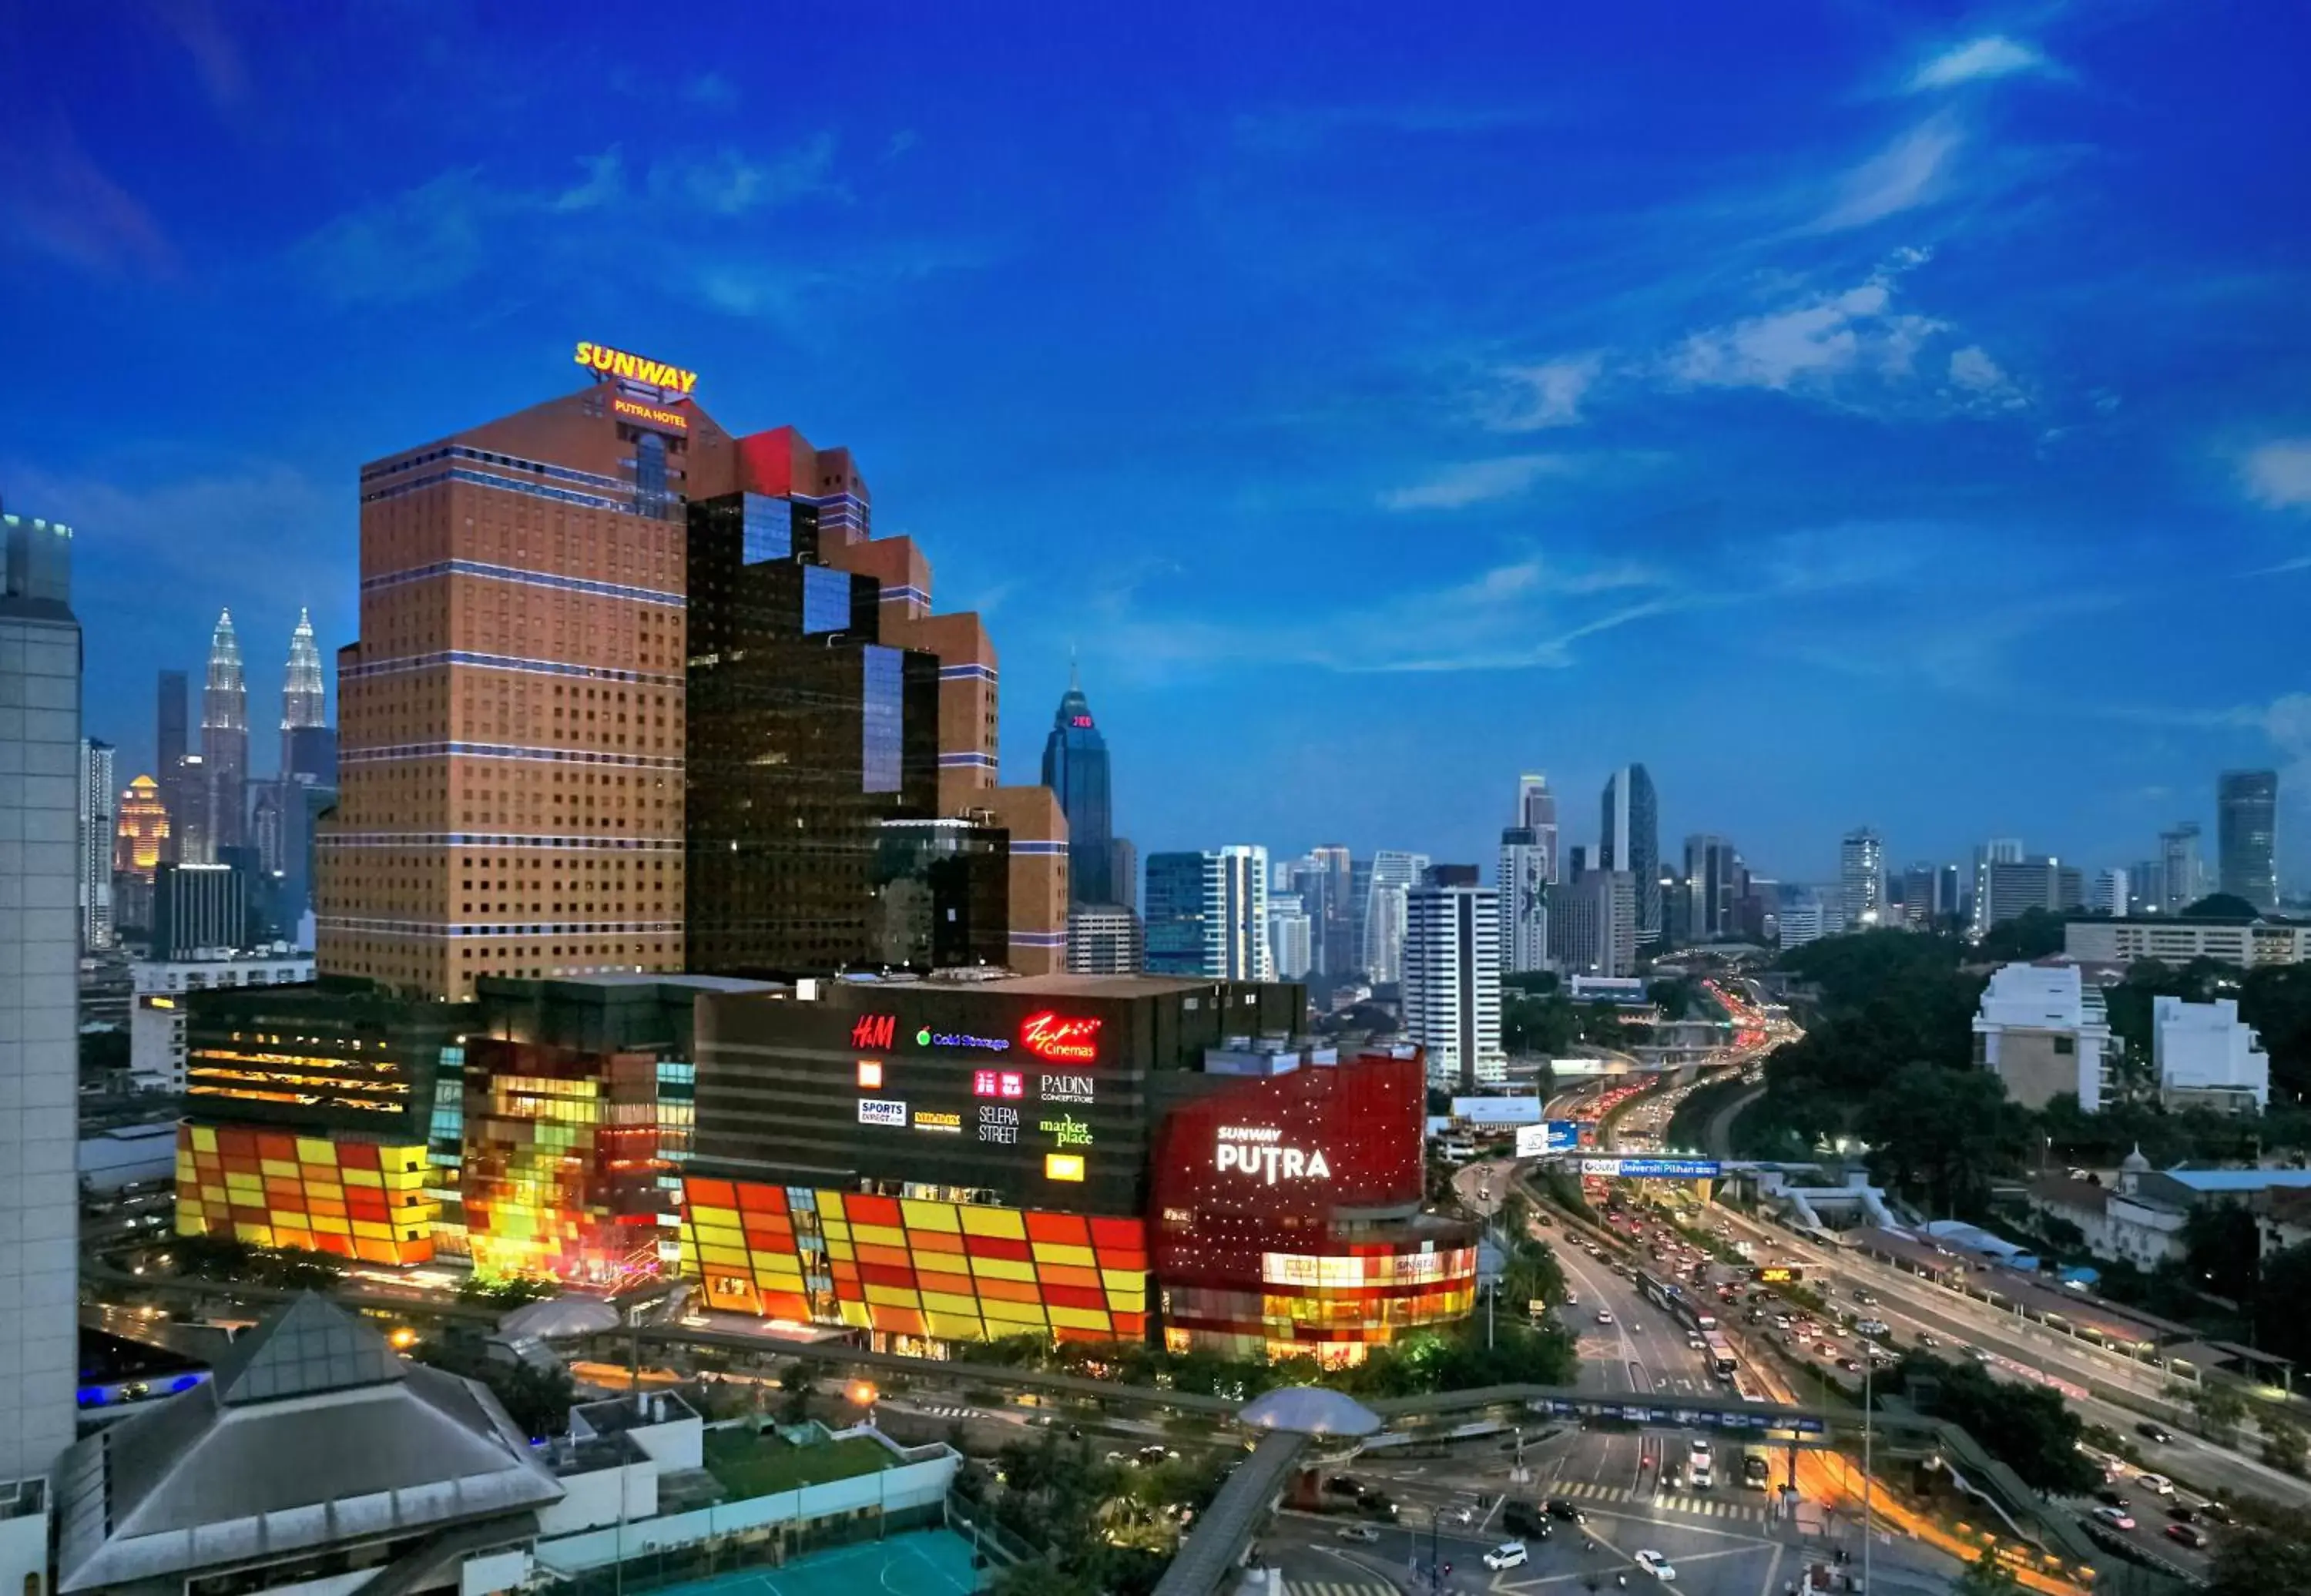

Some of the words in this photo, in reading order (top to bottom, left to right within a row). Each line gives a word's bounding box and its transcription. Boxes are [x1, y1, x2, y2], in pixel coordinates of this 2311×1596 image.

[574, 341, 698, 393] SUNWAY
[615, 400, 652, 420] PUTRA
[654, 409, 687, 428] HOTEL
[852, 1015, 896, 1049] H&M
[933, 1033, 961, 1046] Cold
[1045, 1043, 1094, 1058] Cinemas
[1041, 1075, 1094, 1095] PADINI
[862, 1102, 903, 1115] SPORTS
[979, 1105, 1019, 1125] SELERA
[1040, 1113, 1088, 1134] market
[979, 1125, 1019, 1144] STREET
[1057, 1131, 1093, 1147] place
[1218, 1125, 1282, 1142] SUNWAY
[1218, 1144, 1330, 1185] PUTRA
[1620, 1164, 1662, 1173] Universiti
